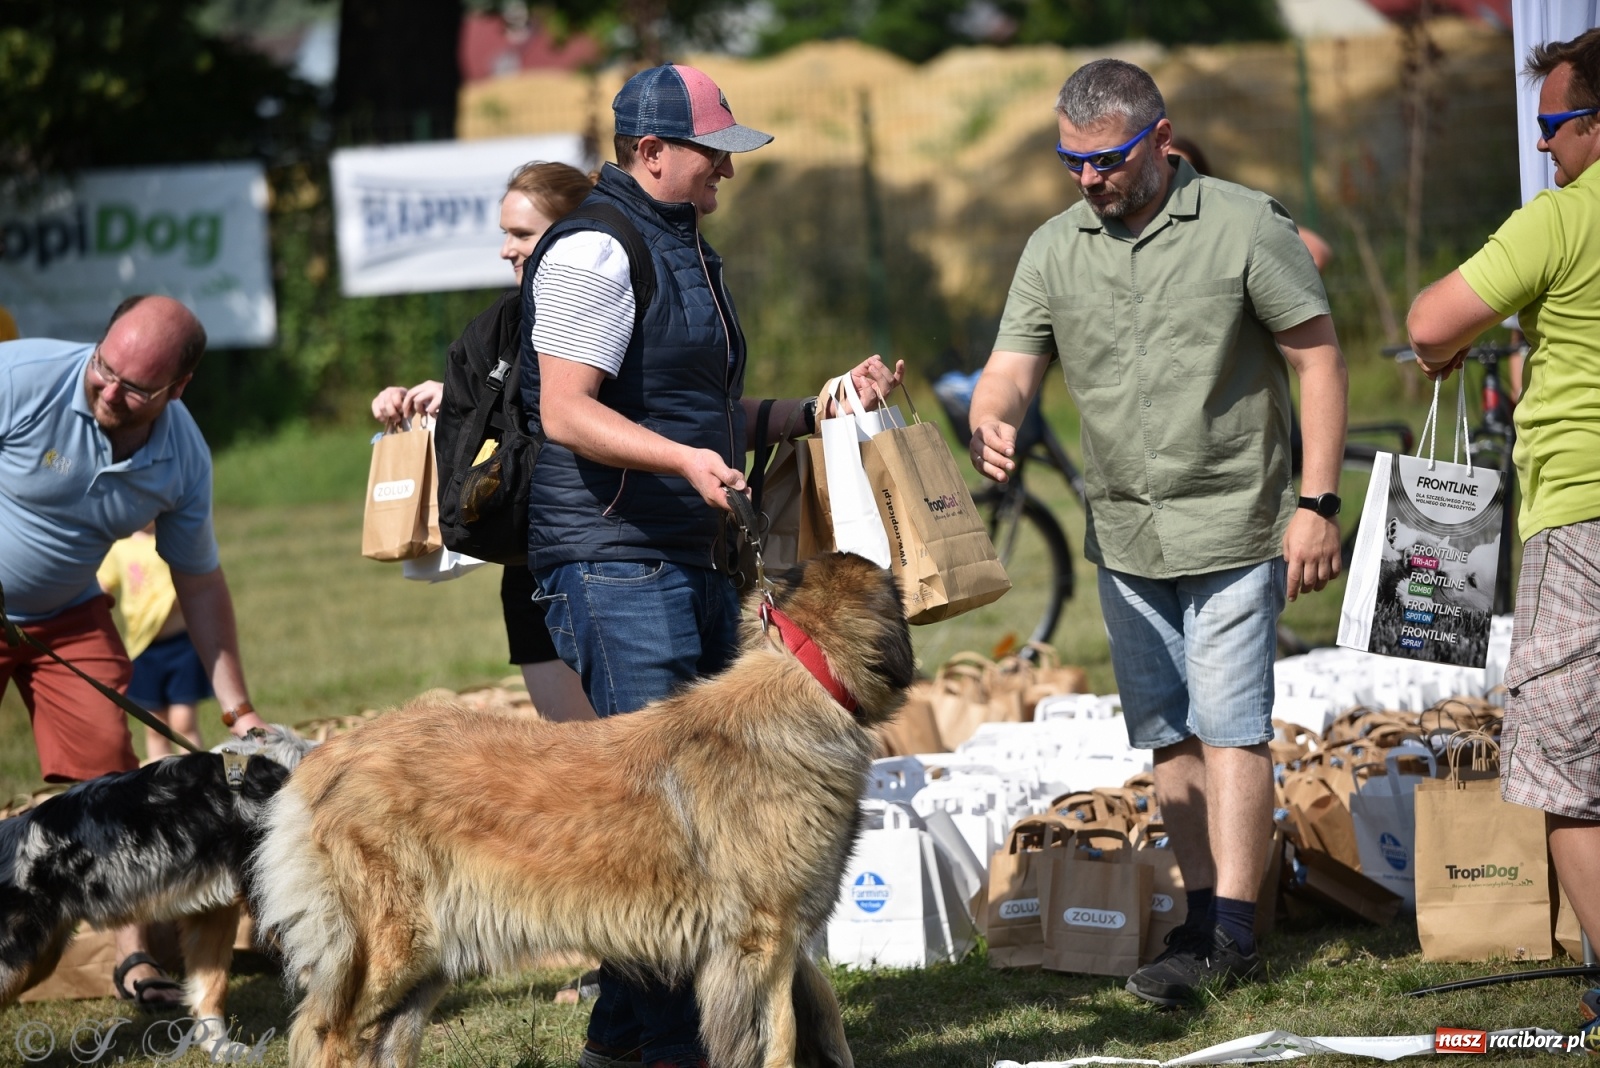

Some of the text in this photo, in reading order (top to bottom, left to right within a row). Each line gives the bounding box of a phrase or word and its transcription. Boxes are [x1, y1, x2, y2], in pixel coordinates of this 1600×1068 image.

[377, 483, 410, 497] ZOLUX
[1416, 476, 1478, 497] FRONTLINE
[923, 493, 959, 513] TropiCat
[881, 488, 908, 568] www.tropicat.pl
[1413, 544, 1469, 562] FRONTLINE
[1413, 557, 1437, 567] TRI-ACT
[1410, 571, 1466, 590] FRONTLINE
[1410, 585, 1432, 595] COMBO
[1405, 611, 1432, 622] SPOT ON
[1406, 599, 1462, 617] FRONTLINE
[1401, 625, 1458, 643] FRONTLINE
[1401, 638, 1423, 648] SPRAY
[1445, 864, 1519, 881] TropiDog
[851, 886, 889, 898] Farmina
[1071, 910, 1117, 925] ZOLUX
